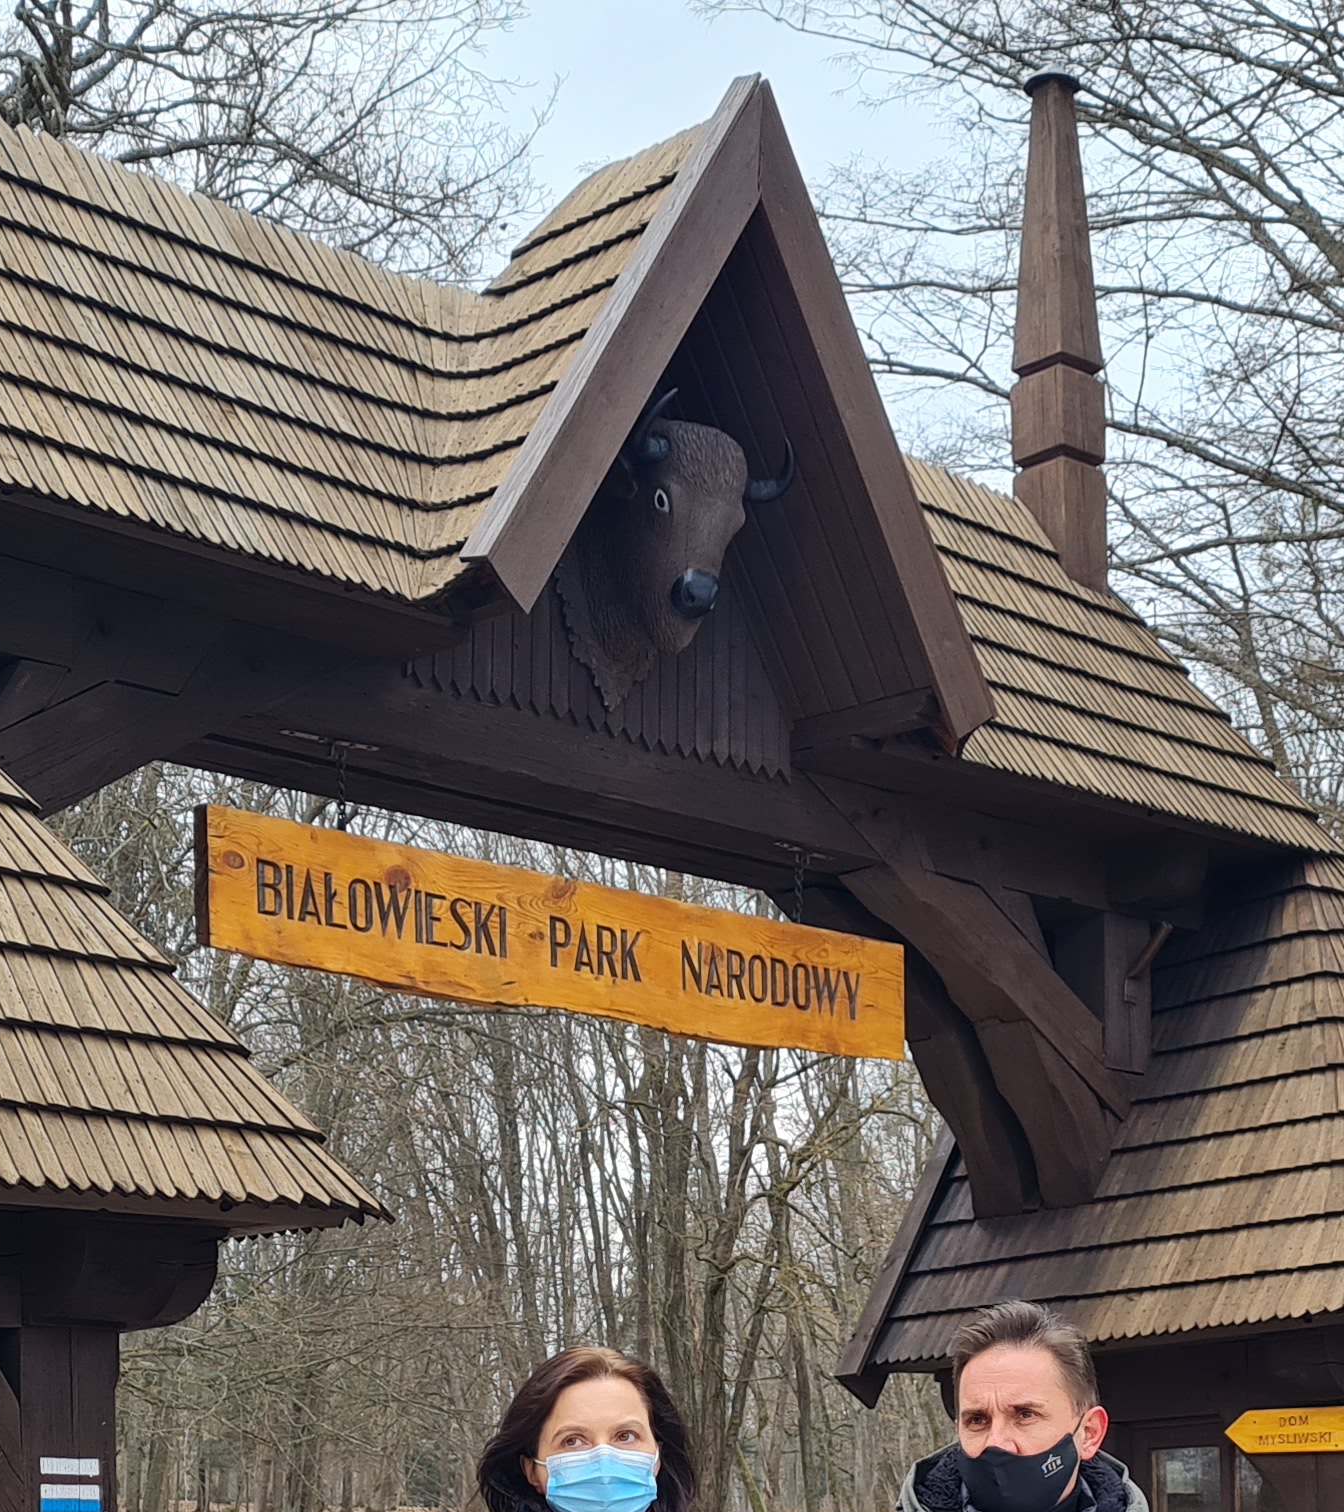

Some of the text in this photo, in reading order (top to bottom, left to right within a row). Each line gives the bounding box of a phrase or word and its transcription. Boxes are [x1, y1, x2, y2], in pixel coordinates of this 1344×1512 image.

[256, 858, 862, 1021] BIAŁOWIESKI PARK NARODOWY
[1279, 1415, 1309, 1427] DOM
